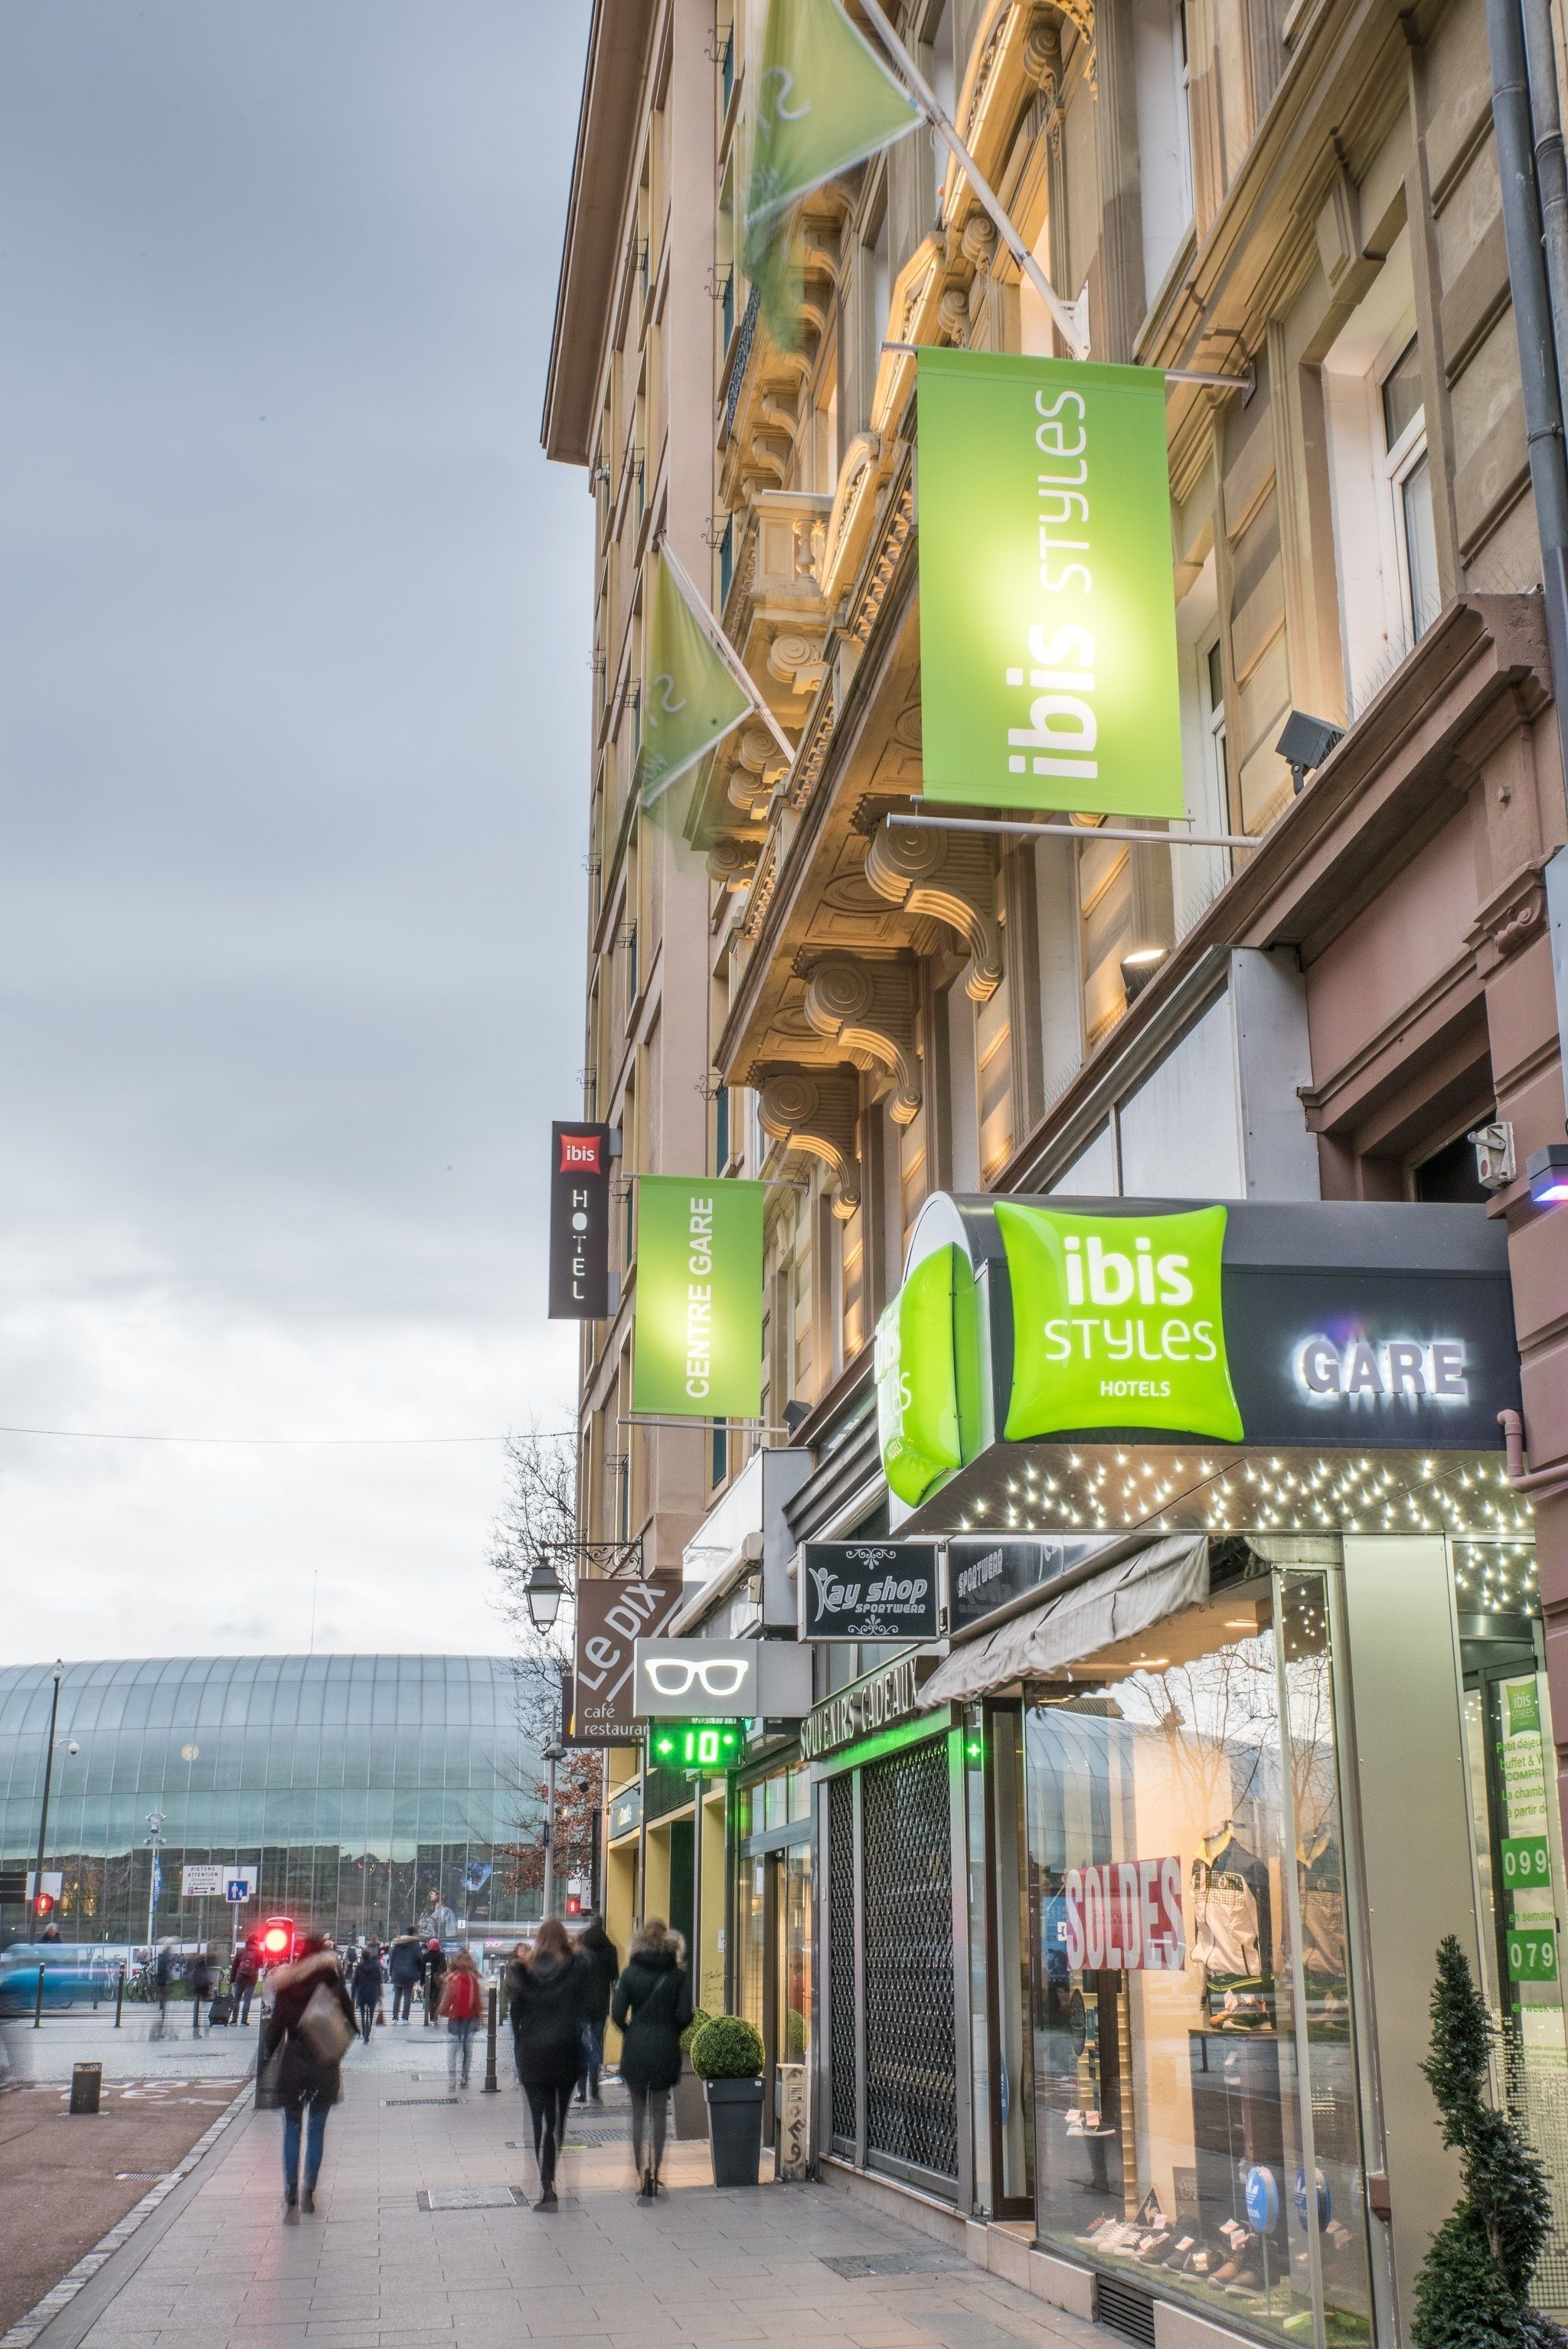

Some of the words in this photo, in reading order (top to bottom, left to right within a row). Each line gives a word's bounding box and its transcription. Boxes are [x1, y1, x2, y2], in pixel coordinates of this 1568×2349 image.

[1006, 625, 1099, 779] ibis
[566, 1145, 595, 1161] ibis
[572, 1190, 587, 1299] HOTEL
[689, 1197, 713, 1275] GARE
[1064, 1237, 1194, 1305] ibis
[686, 1285, 711, 1398] CENTRE
[1302, 1341, 1466, 1394] GARE
[1100, 1380, 1171, 1397] HOTELS
[958, 1548, 1003, 1598] SPORTWEAR
[866, 1576, 928, 1604] shop
[603, 1583, 666, 1641] DIX
[855, 1603, 926, 1613] SPORTWEAR
[584, 1703, 616, 1717] café
[800, 1694, 855, 1762] SOUVENIRS
[861, 1655, 919, 1733] CADEAUX
[1513, 1691, 1531, 1709] ibis
[1496, 1740, 1516, 1753] Petit
[1500, 1756, 1526, 1770] buffet
[1528, 1755, 1535, 1766] &
[1502, 1789, 1513, 1801] La
[1514, 1804, 1537, 1819] partir
[1504, 1849, 1547, 1876] 099
[1065, 1857, 1185, 1970] SOLDES
[1509, 1912, 1520, 1923] en
[1522, 1910, 1555, 1922] semain
[1510, 1942, 1554, 1968] 079
